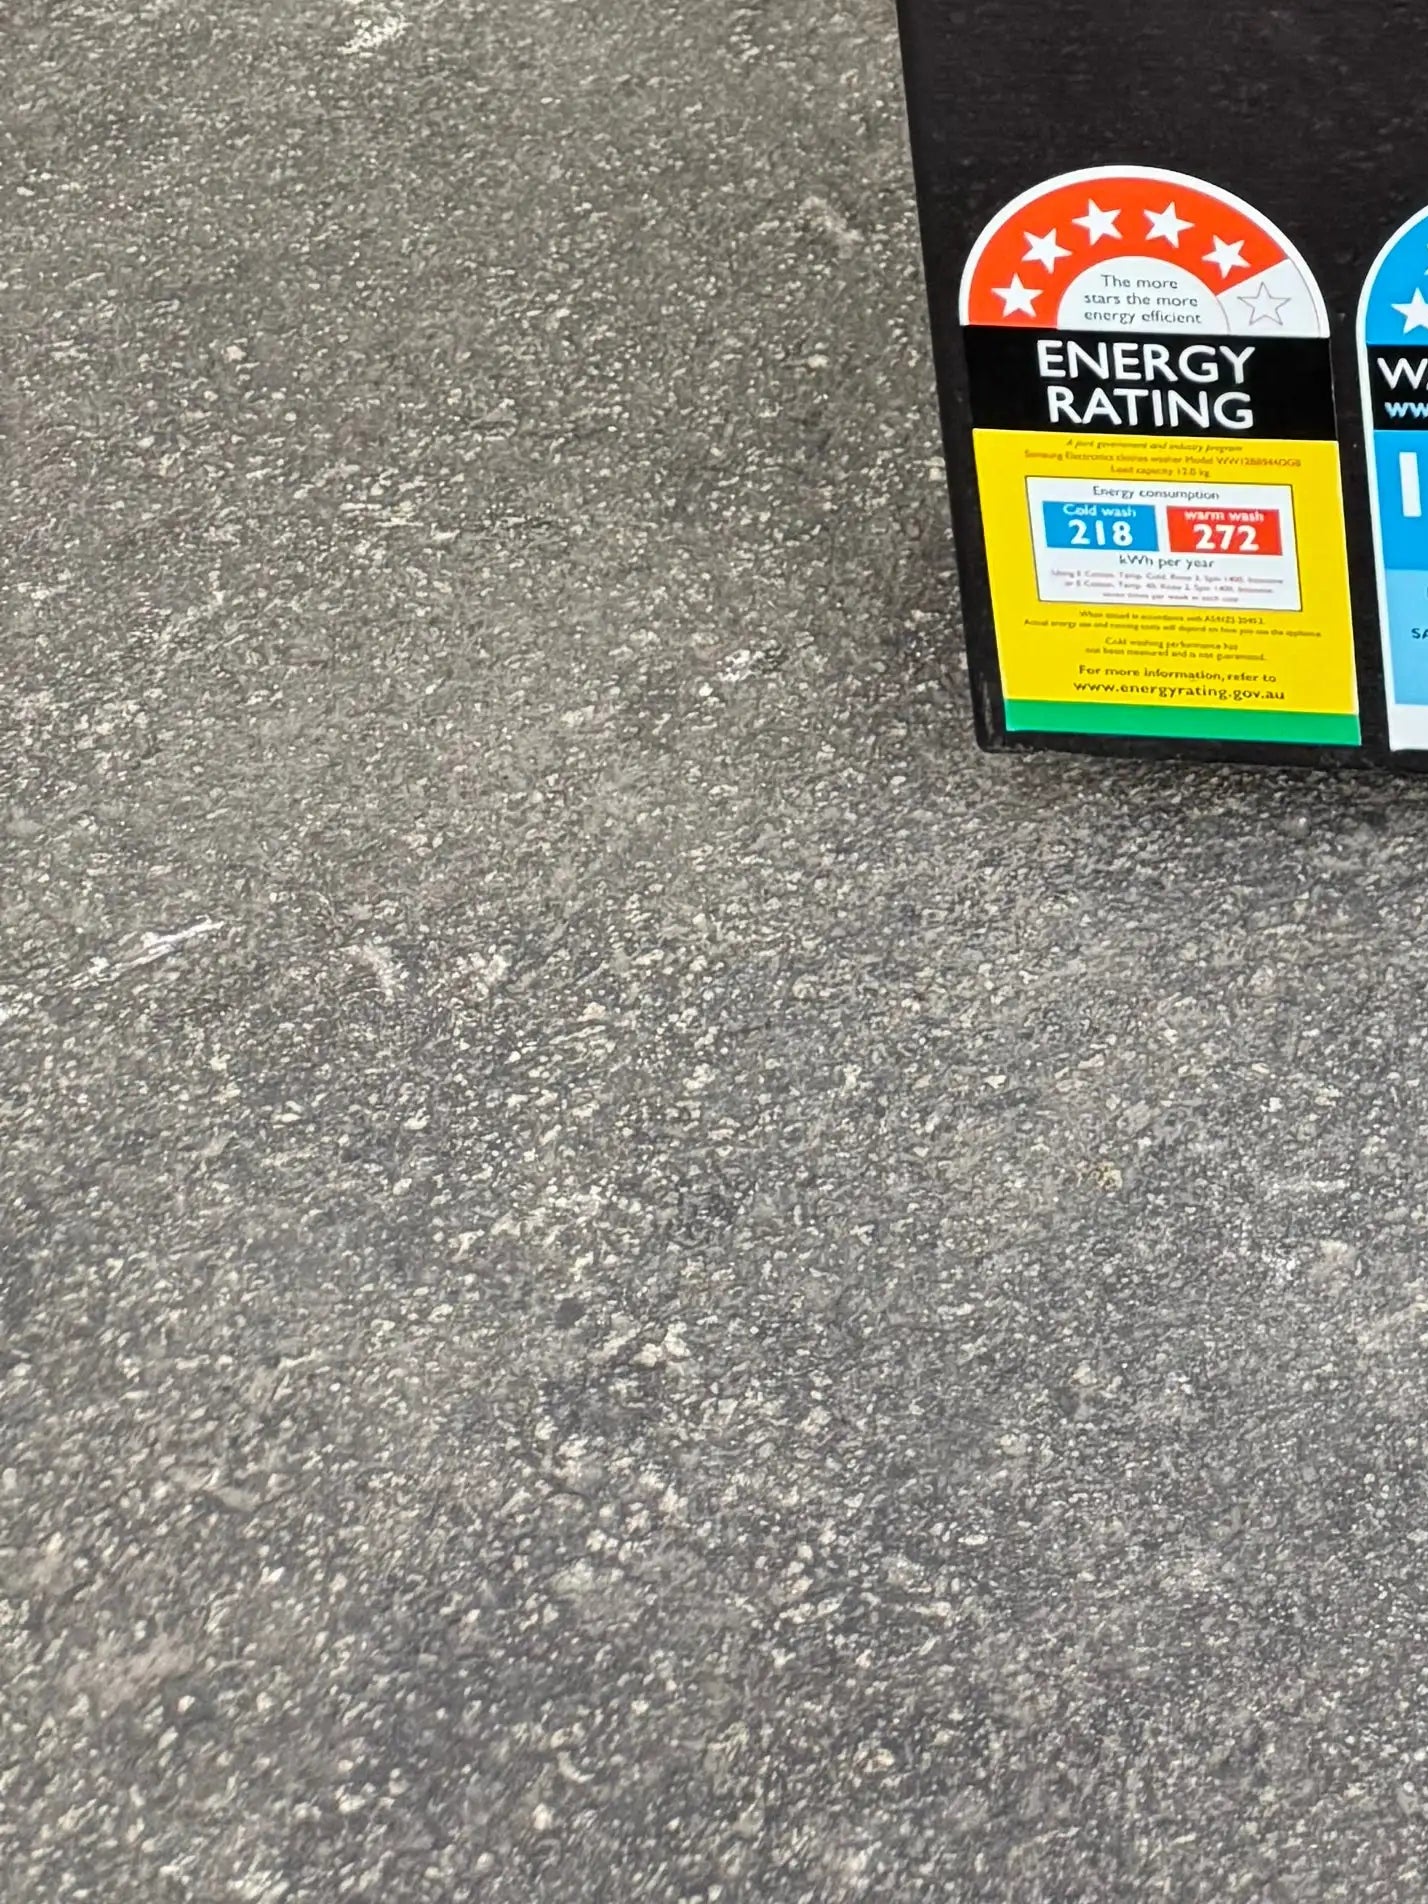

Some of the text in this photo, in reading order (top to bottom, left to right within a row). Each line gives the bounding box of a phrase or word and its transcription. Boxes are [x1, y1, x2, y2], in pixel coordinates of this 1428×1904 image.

[1100, 274, 1178, 289] The more
[1083, 293, 1198, 307] stars the more
[1083, 310, 1202, 324] energy efficient
[1037, 340, 1255, 384] ENERGY
[1047, 386, 1254, 429] RATING
[1092, 485, 1219, 500] Energy consumption
[1063, 504, 1135, 516] Cold wash
[1184, 511, 1263, 521] warm wash
[1068, 519, 1133, 546] 218
[1193, 524, 1259, 551] 272
[1119, 554, 1213, 569] kWh per year
[1079, 664, 1100, 674] For
[1227, 672, 1258, 680] refer
[1262, 674, 1276, 682] to
[1073, 679, 1285, 701] www.energyrating.gov.au
